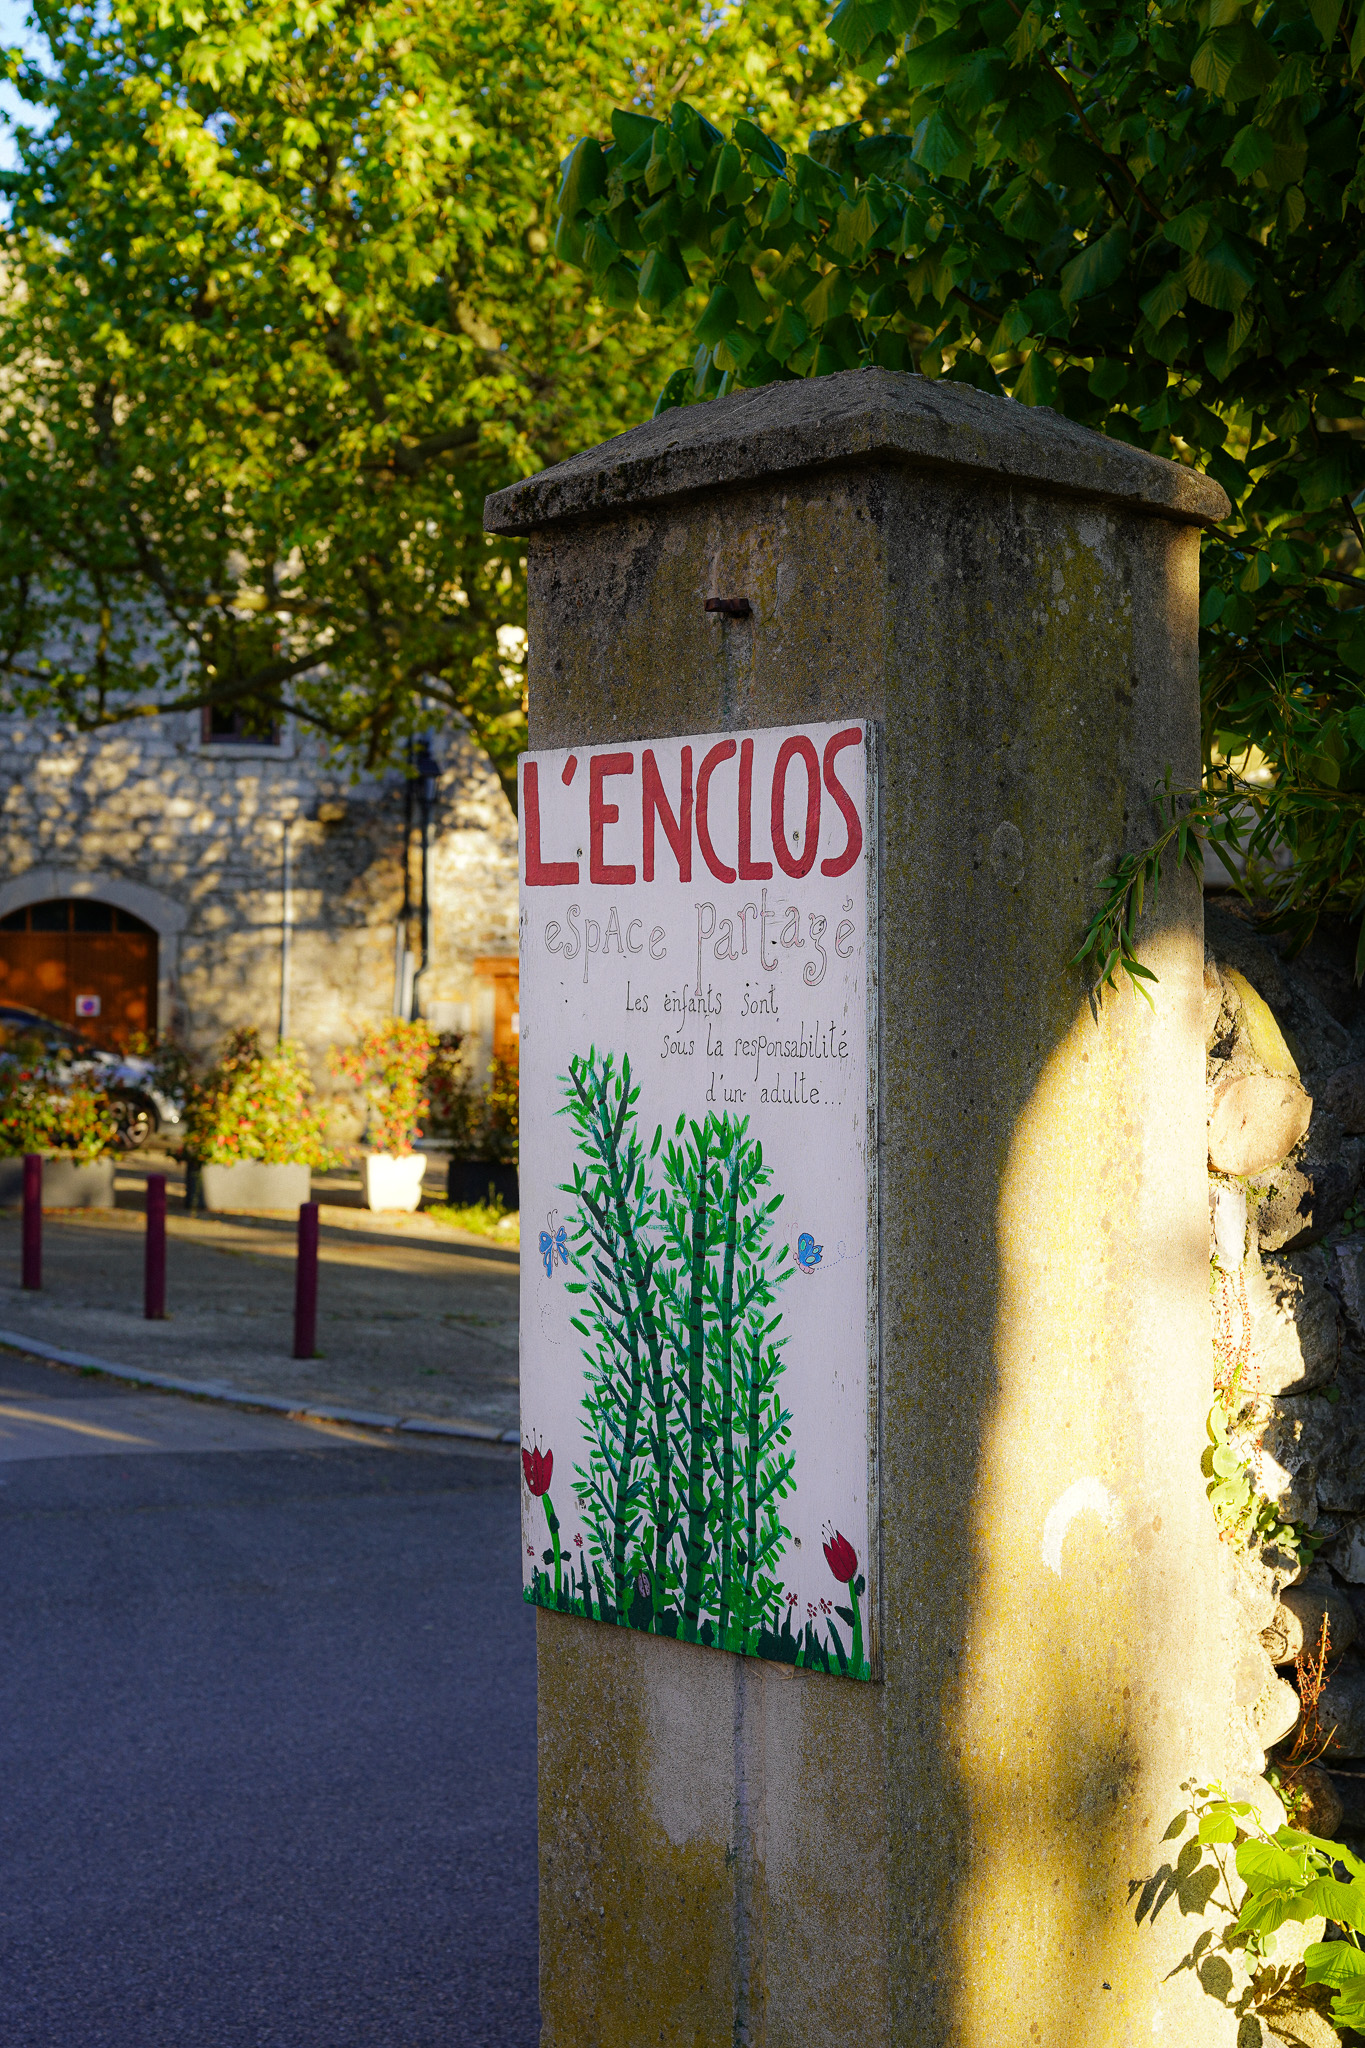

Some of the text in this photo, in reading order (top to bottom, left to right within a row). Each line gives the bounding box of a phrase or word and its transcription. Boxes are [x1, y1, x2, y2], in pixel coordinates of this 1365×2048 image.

[523, 726, 863, 886] L'ENCLOS
[625, 980, 649, 1013] Les
[663, 983, 722, 1034] enfants
[706, 1022, 724, 1057] la
[734, 1020, 849, 1082] responsabilité
[705, 1071, 746, 1103] d'un
